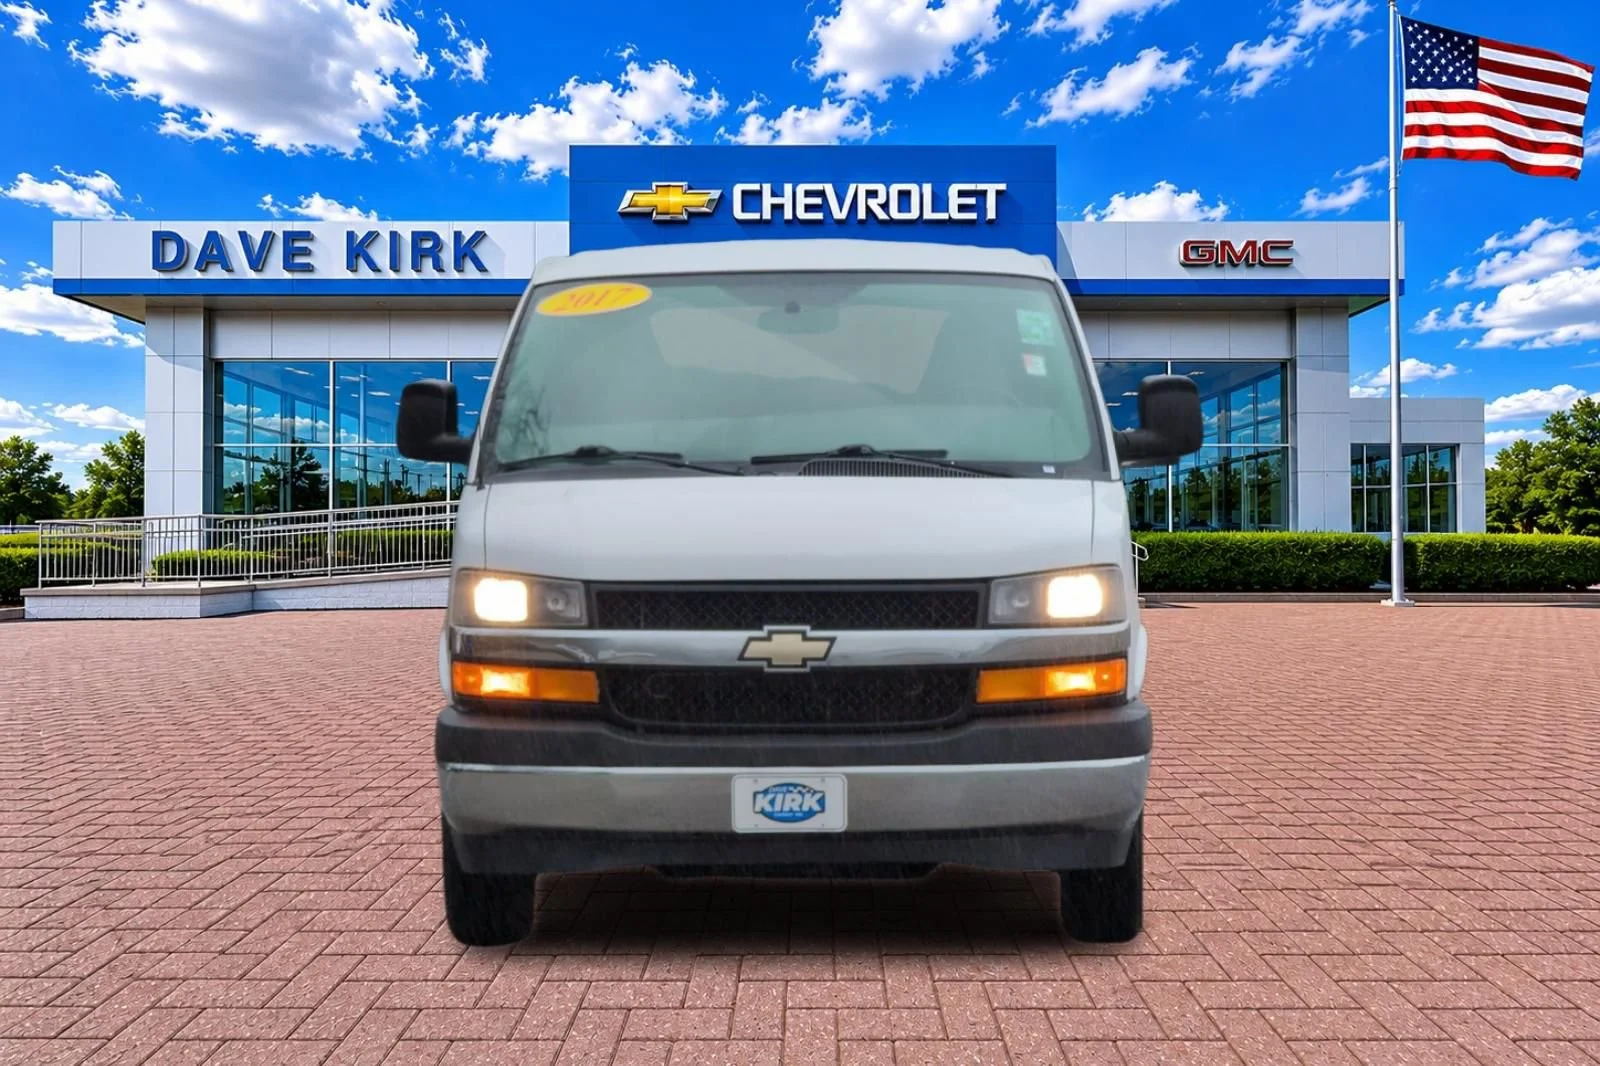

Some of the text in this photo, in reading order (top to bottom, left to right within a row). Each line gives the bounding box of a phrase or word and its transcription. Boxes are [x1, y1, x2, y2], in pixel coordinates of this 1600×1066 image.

[732, 183, 1007, 221] CHEVROLET
[152, 230, 488, 272] DAVE KIRK
[1179, 239, 1294, 267] GMC
[551, 286, 635, 312] 2017
[754, 793, 824, 812] KIRK
